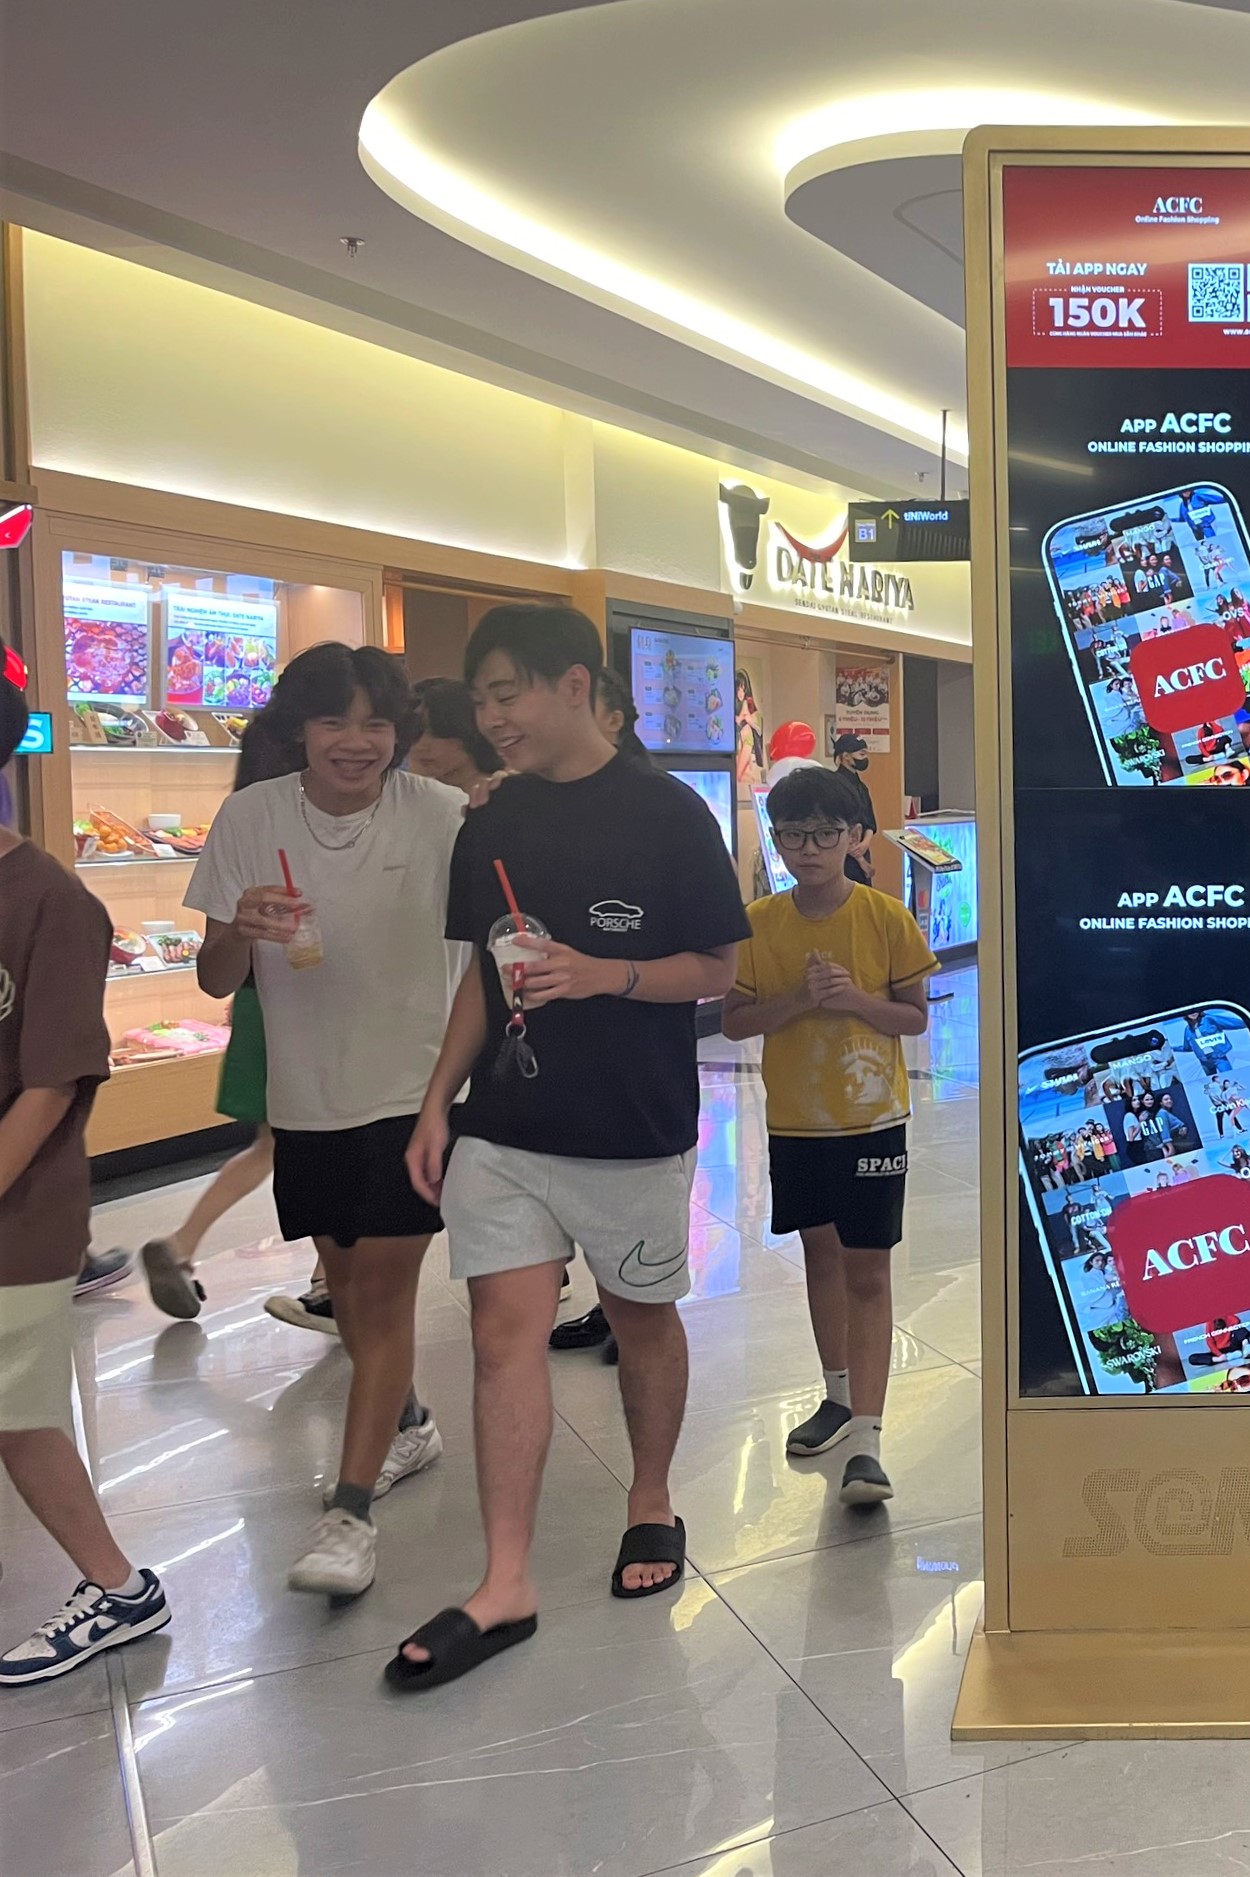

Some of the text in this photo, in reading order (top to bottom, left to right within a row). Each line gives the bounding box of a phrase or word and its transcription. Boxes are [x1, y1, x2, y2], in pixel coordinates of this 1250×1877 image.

[1152, 196, 1203, 214] ACFC
[1135, 215, 1220, 225] Online Fashion Shopping
[1046, 258, 1148, 276] TẢI APP NGAY
[1092, 285, 1125, 294] VOUCHER
[1048, 297, 1147, 328] 150K
[1120, 412, 1232, 433] APP ACFC
[1087, 441, 1136, 453] ONLINE
[1139, 441, 1196, 453] FASHION
[903, 510, 949, 522] tiNiWorld
[858, 528, 875, 541] B1
[1147, 573, 1166, 589] GAP
[1222, 608, 1244, 621] OVS
[1153, 657, 1227, 698] ACFC
[20, 719, 45, 749] S
[1117, 885, 1245, 907] APP ACFC
[590, 917, 641, 929] PORSCHE
[1079, 917, 1135, 930] ONLINE
[1138, 917, 1203, 929] FASHION
[1112, 1054, 1152, 1070] MANGO
[1209, 1102, 1235, 1114] Calvin
[1140, 1116, 1164, 1137] GAP
[1142, 1225, 1250, 1281] ACFC
[1103, 1345, 1162, 1368] SWAROVSKI
